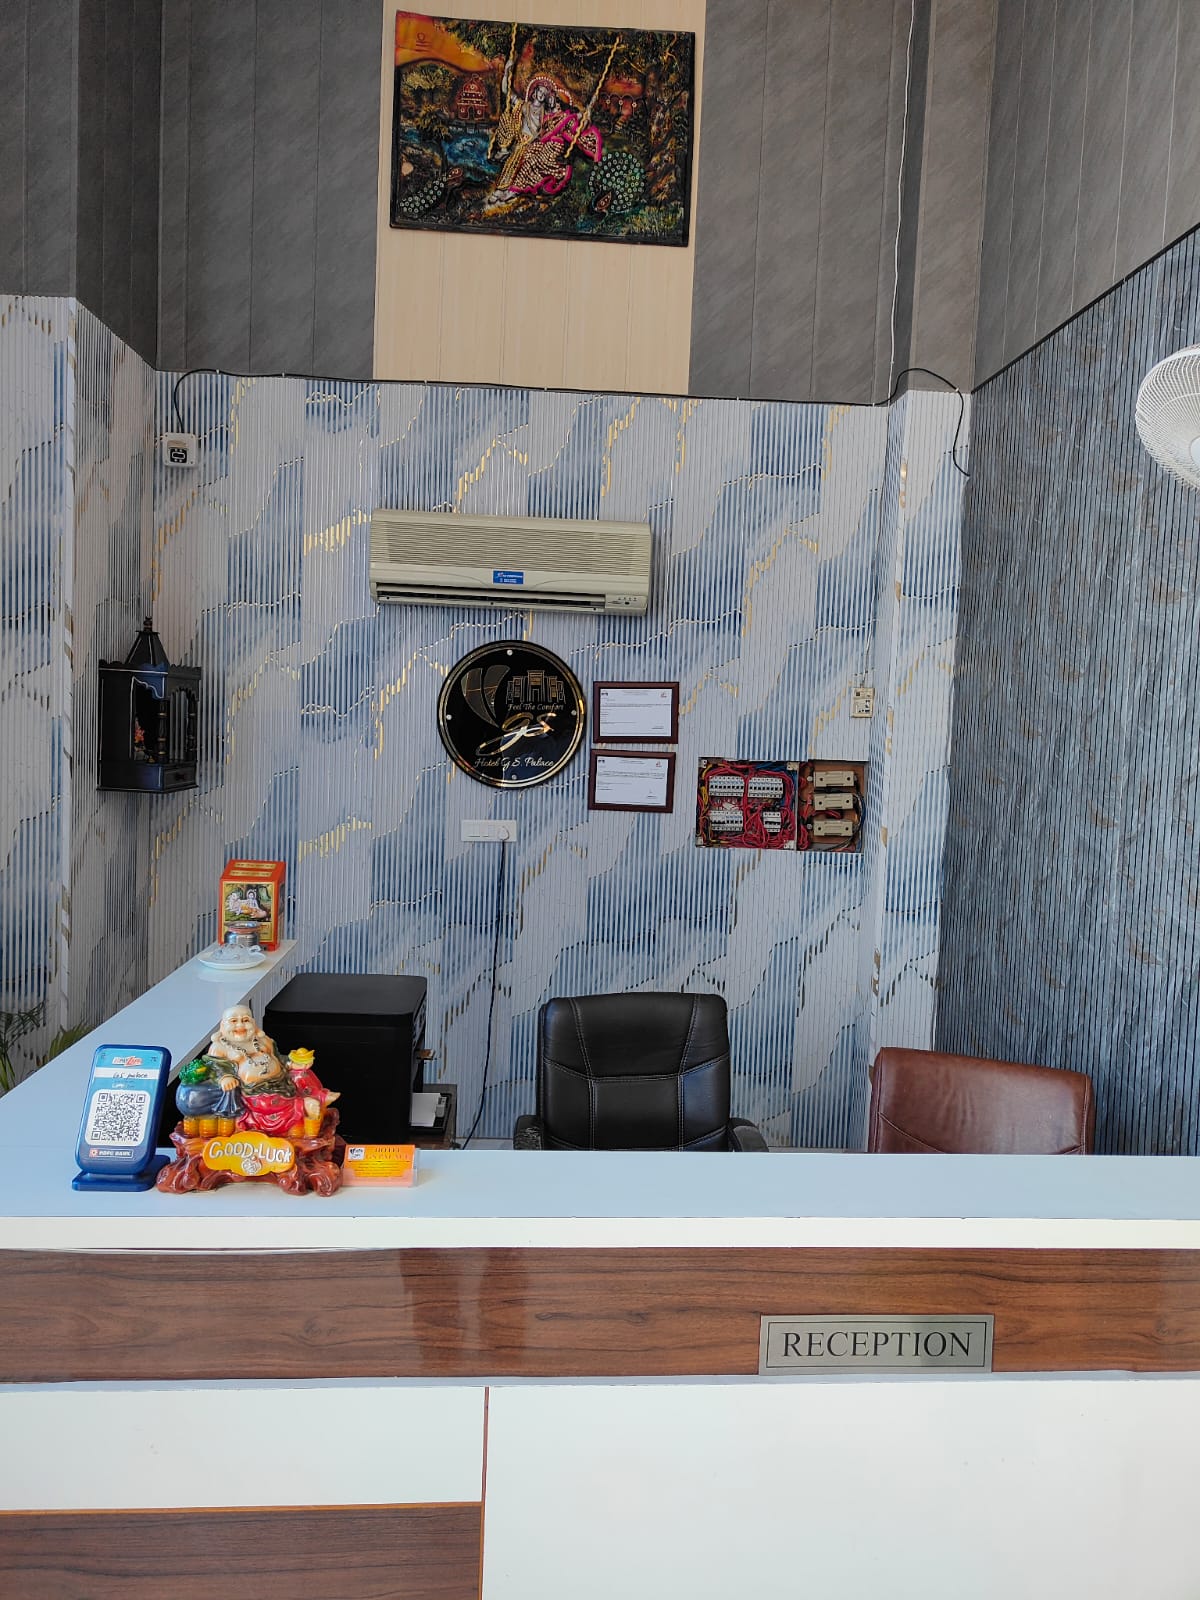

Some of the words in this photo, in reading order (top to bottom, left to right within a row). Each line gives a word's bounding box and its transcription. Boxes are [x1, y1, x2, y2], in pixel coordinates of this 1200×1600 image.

[475, 757, 500, 768] Hotel
[524, 756, 554, 767] Palace
[782, 1331, 973, 1357] RECEPTION
